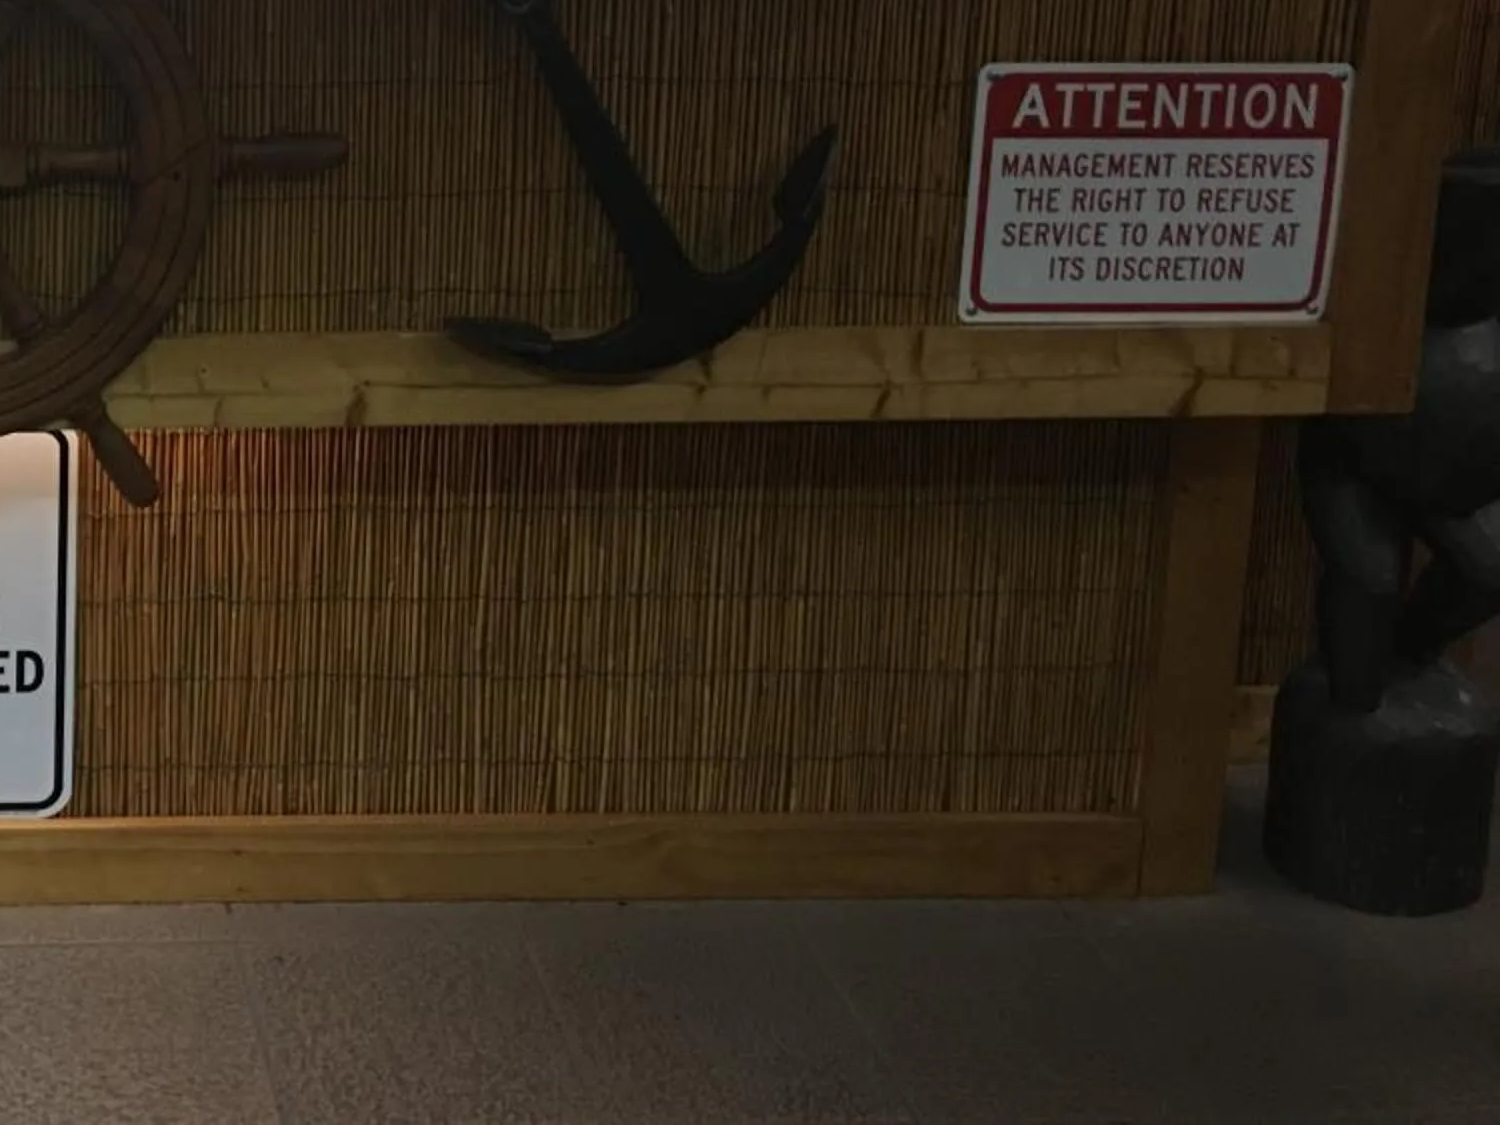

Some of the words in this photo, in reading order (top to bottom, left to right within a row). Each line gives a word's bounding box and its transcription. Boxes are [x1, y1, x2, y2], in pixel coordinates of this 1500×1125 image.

[1012, 83, 1318, 129] ATTENTION
[1001, 153, 1177, 179] MANAGEMENT
[1186, 154, 1315, 179] RESERVES
[1014, 188, 1061, 213] THE
[1071, 188, 1147, 213] RIGHT
[1157, 188, 1186, 213] TO
[1196, 188, 1296, 213] REFUSE
[1001, 222, 1109, 247] SERVICE
[1120, 222, 1148, 247] TO
[1158, 222, 1262, 247] ANYONE
[1271, 223, 1301, 247] AT
[1048, 257, 1085, 281] ITS
[1096, 257, 1246, 281] DISCRETION
